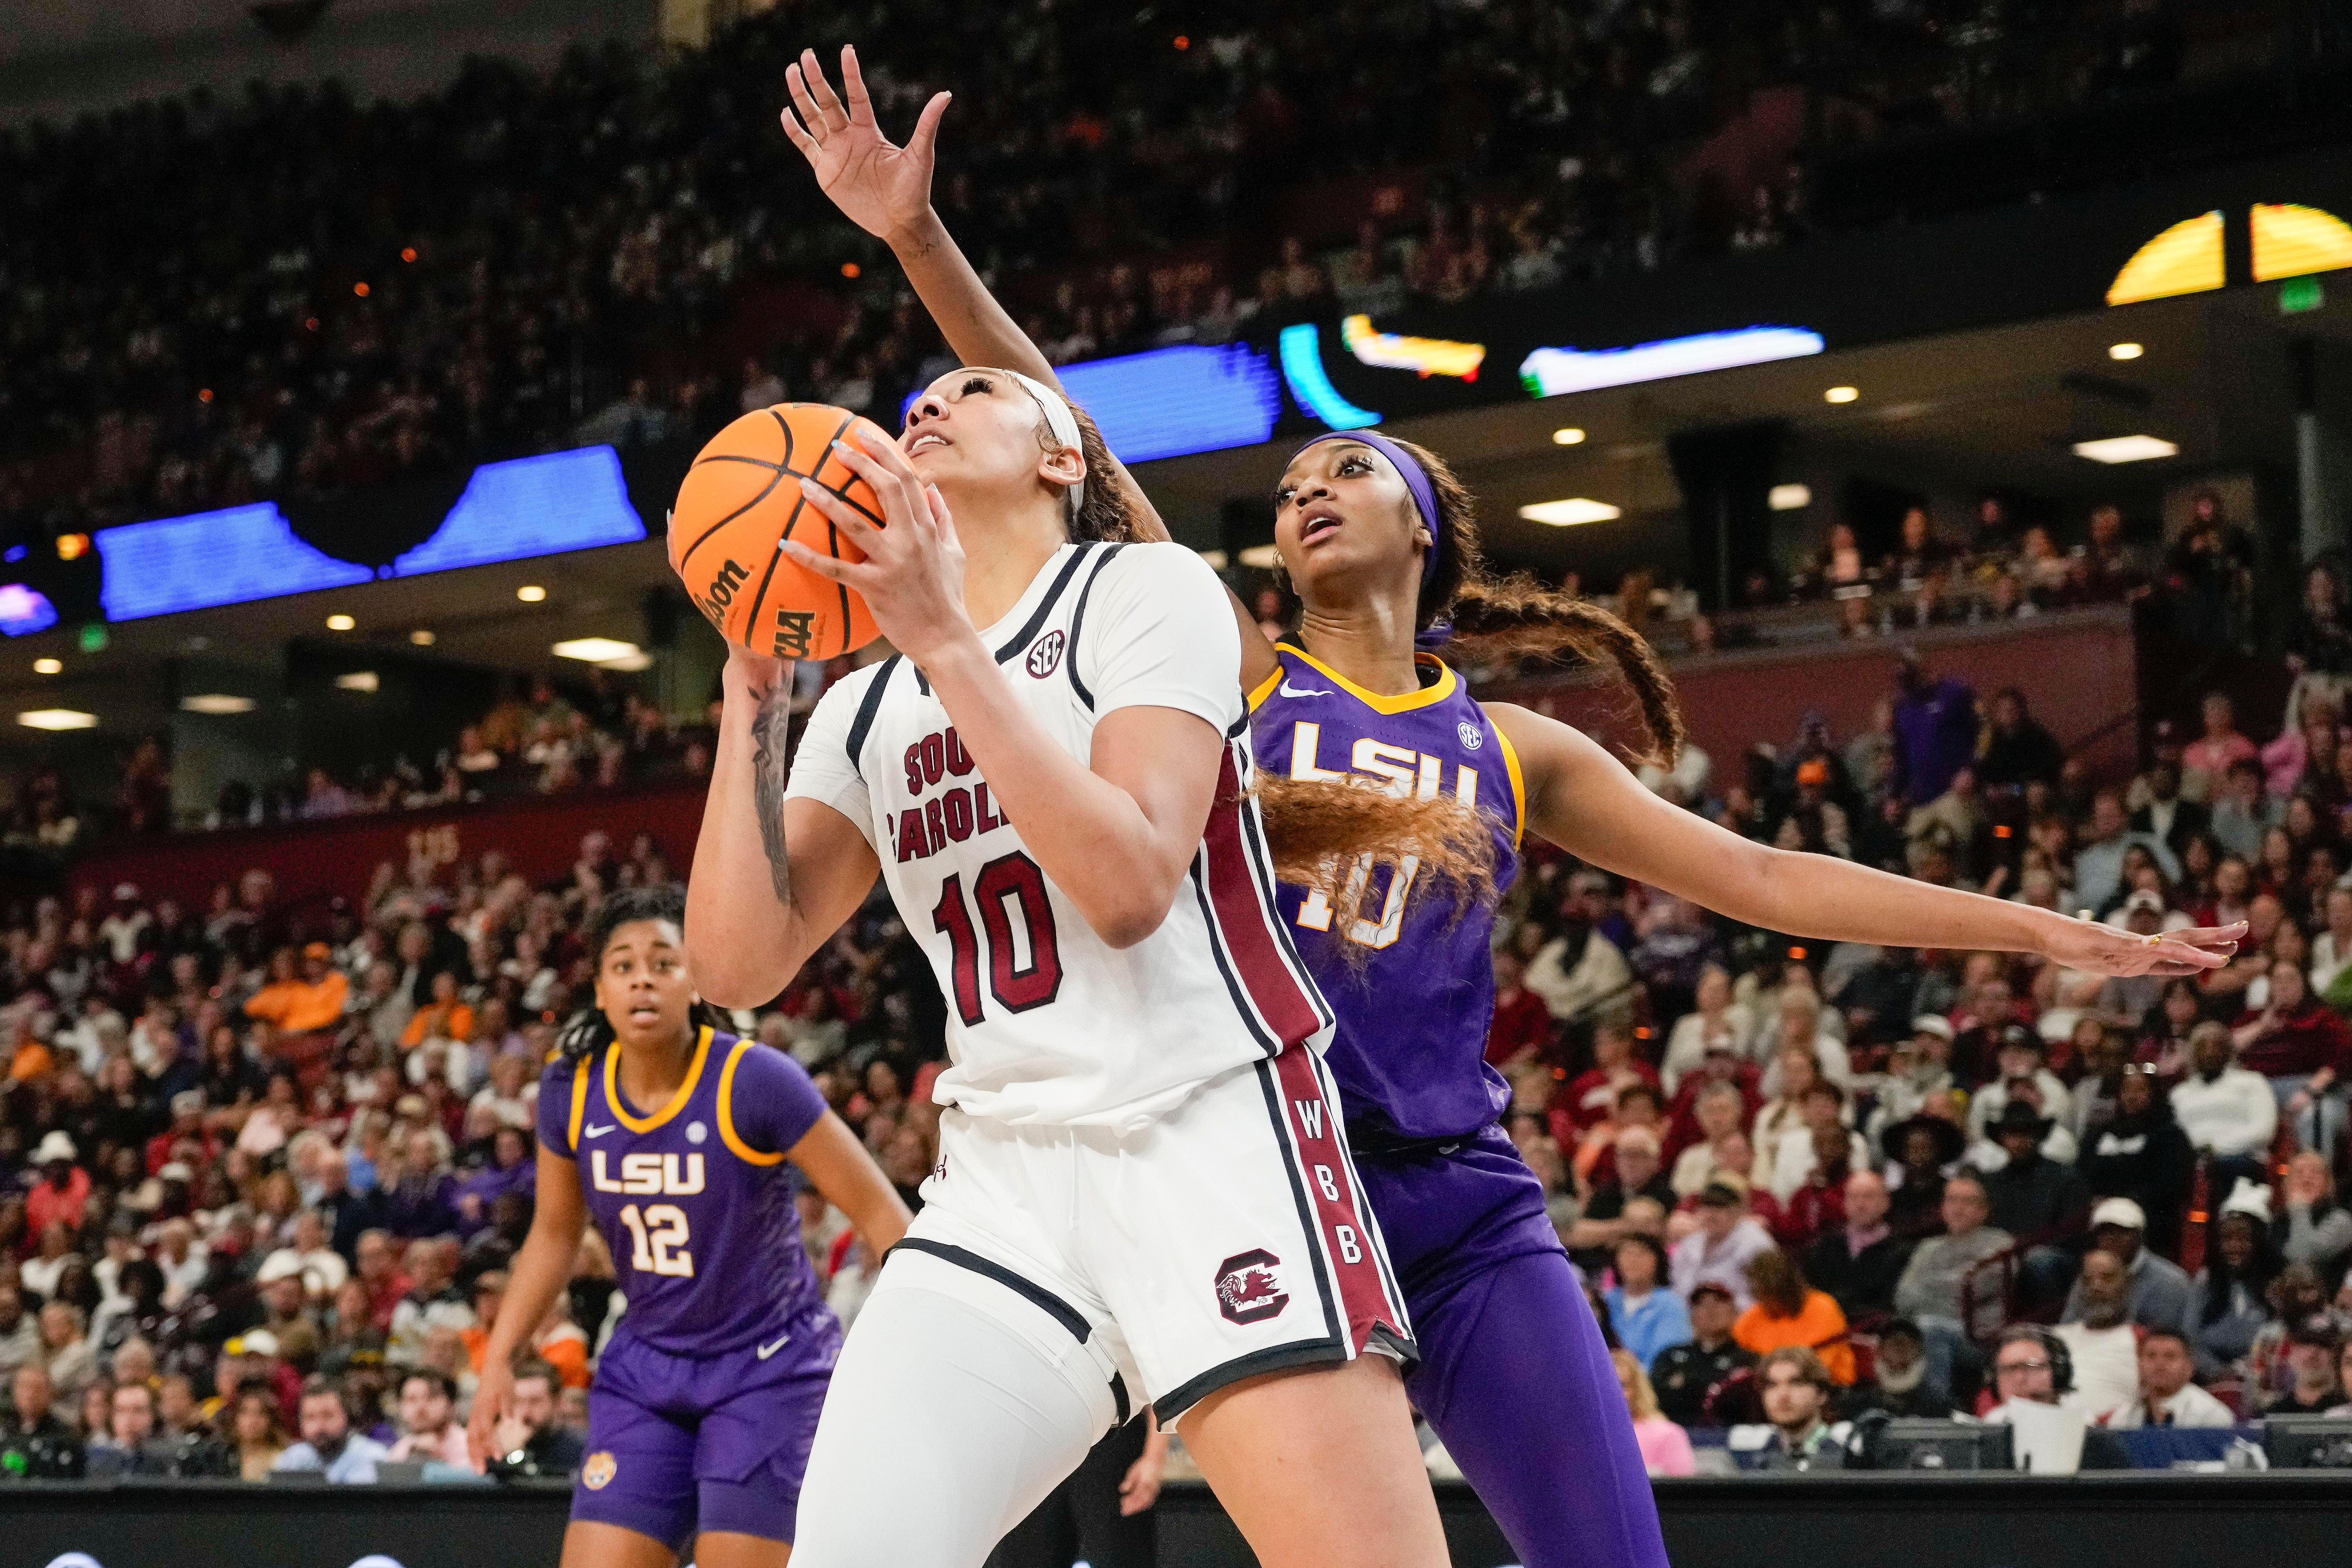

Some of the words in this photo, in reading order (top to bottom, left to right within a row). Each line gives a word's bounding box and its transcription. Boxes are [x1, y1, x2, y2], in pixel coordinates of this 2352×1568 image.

[1030, 632, 1062, 675] SEC
[904, 726, 975, 796] SOU
[1290, 721, 1478, 812] LSU
[1459, 724, 1480, 748] SEC
[886, 781, 1011, 863] AROL
[1297, 851, 1420, 950] 10
[932, 850, 1063, 1027] 10
[591, 1148, 706, 1195] LSU
[619, 1203, 694, 1277] 12
